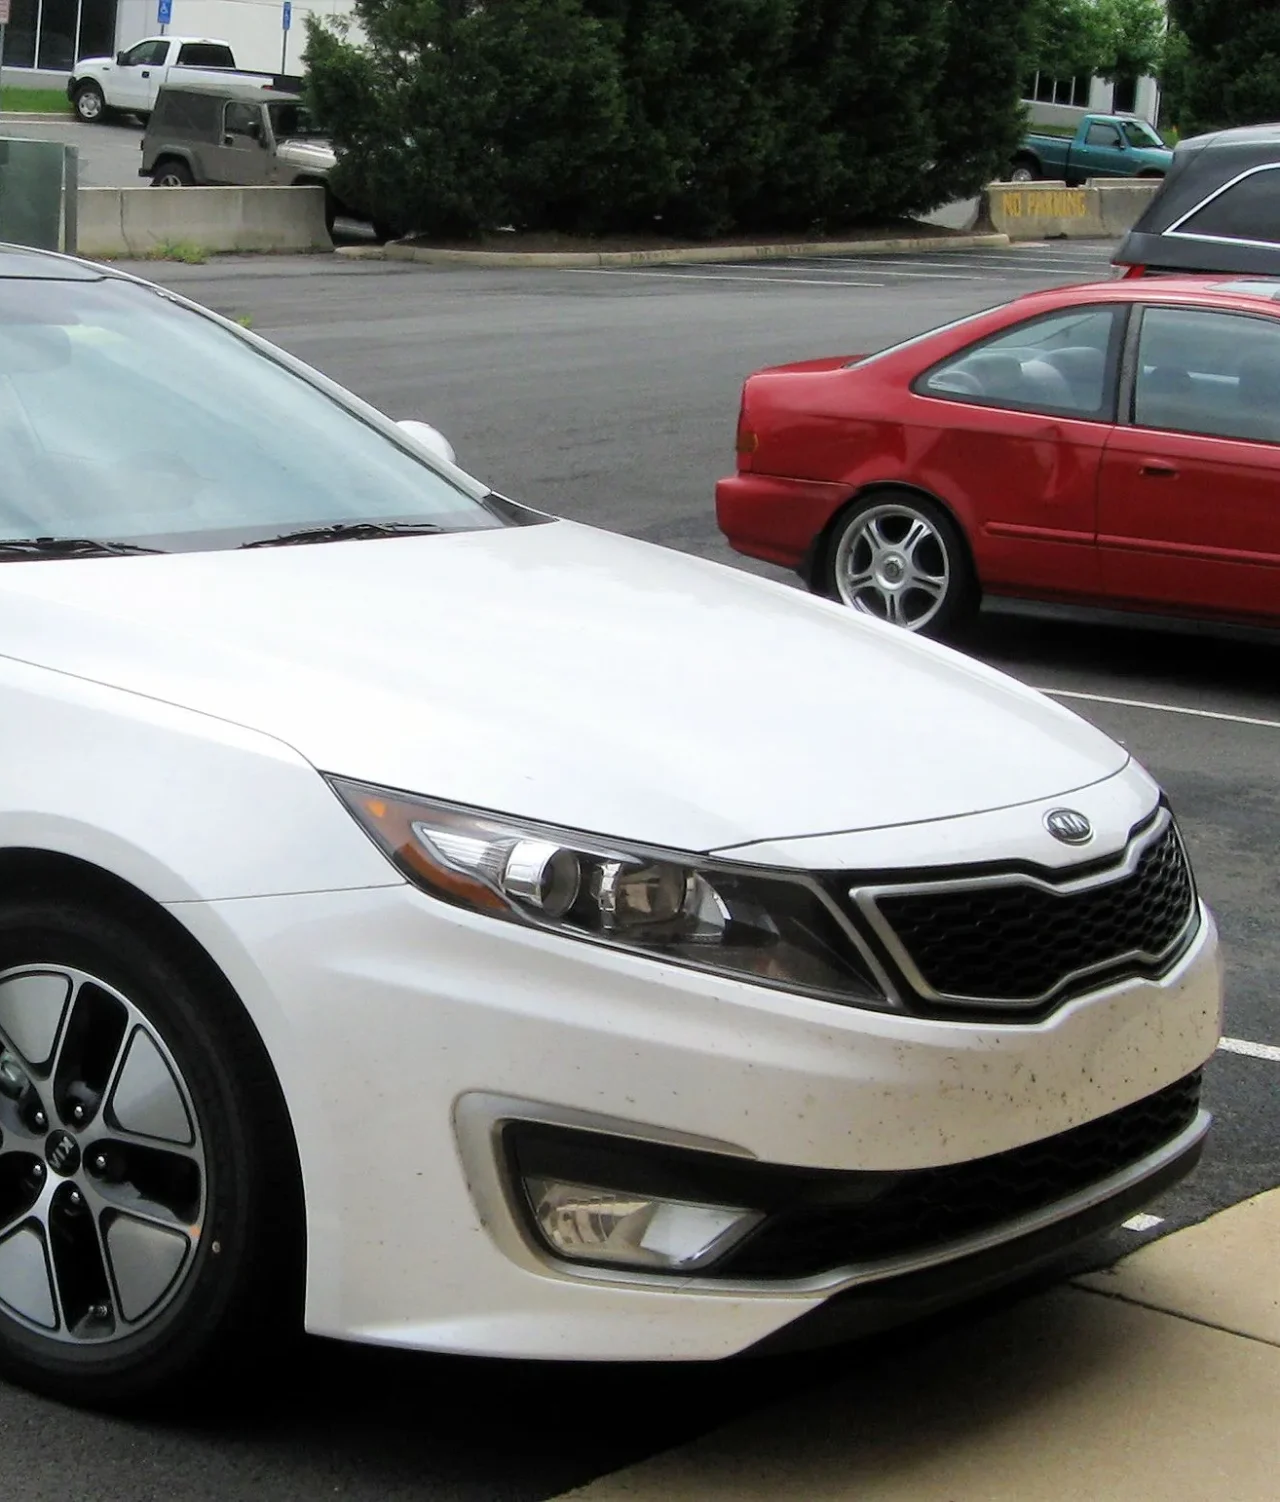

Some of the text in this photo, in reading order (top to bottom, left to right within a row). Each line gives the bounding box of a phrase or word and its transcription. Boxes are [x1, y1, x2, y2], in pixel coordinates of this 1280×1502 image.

[1003, 192, 1087, 217] NO PARKING
[1050, 813, 1089, 836] KIA
[49, 1136, 74, 1168] KIA
